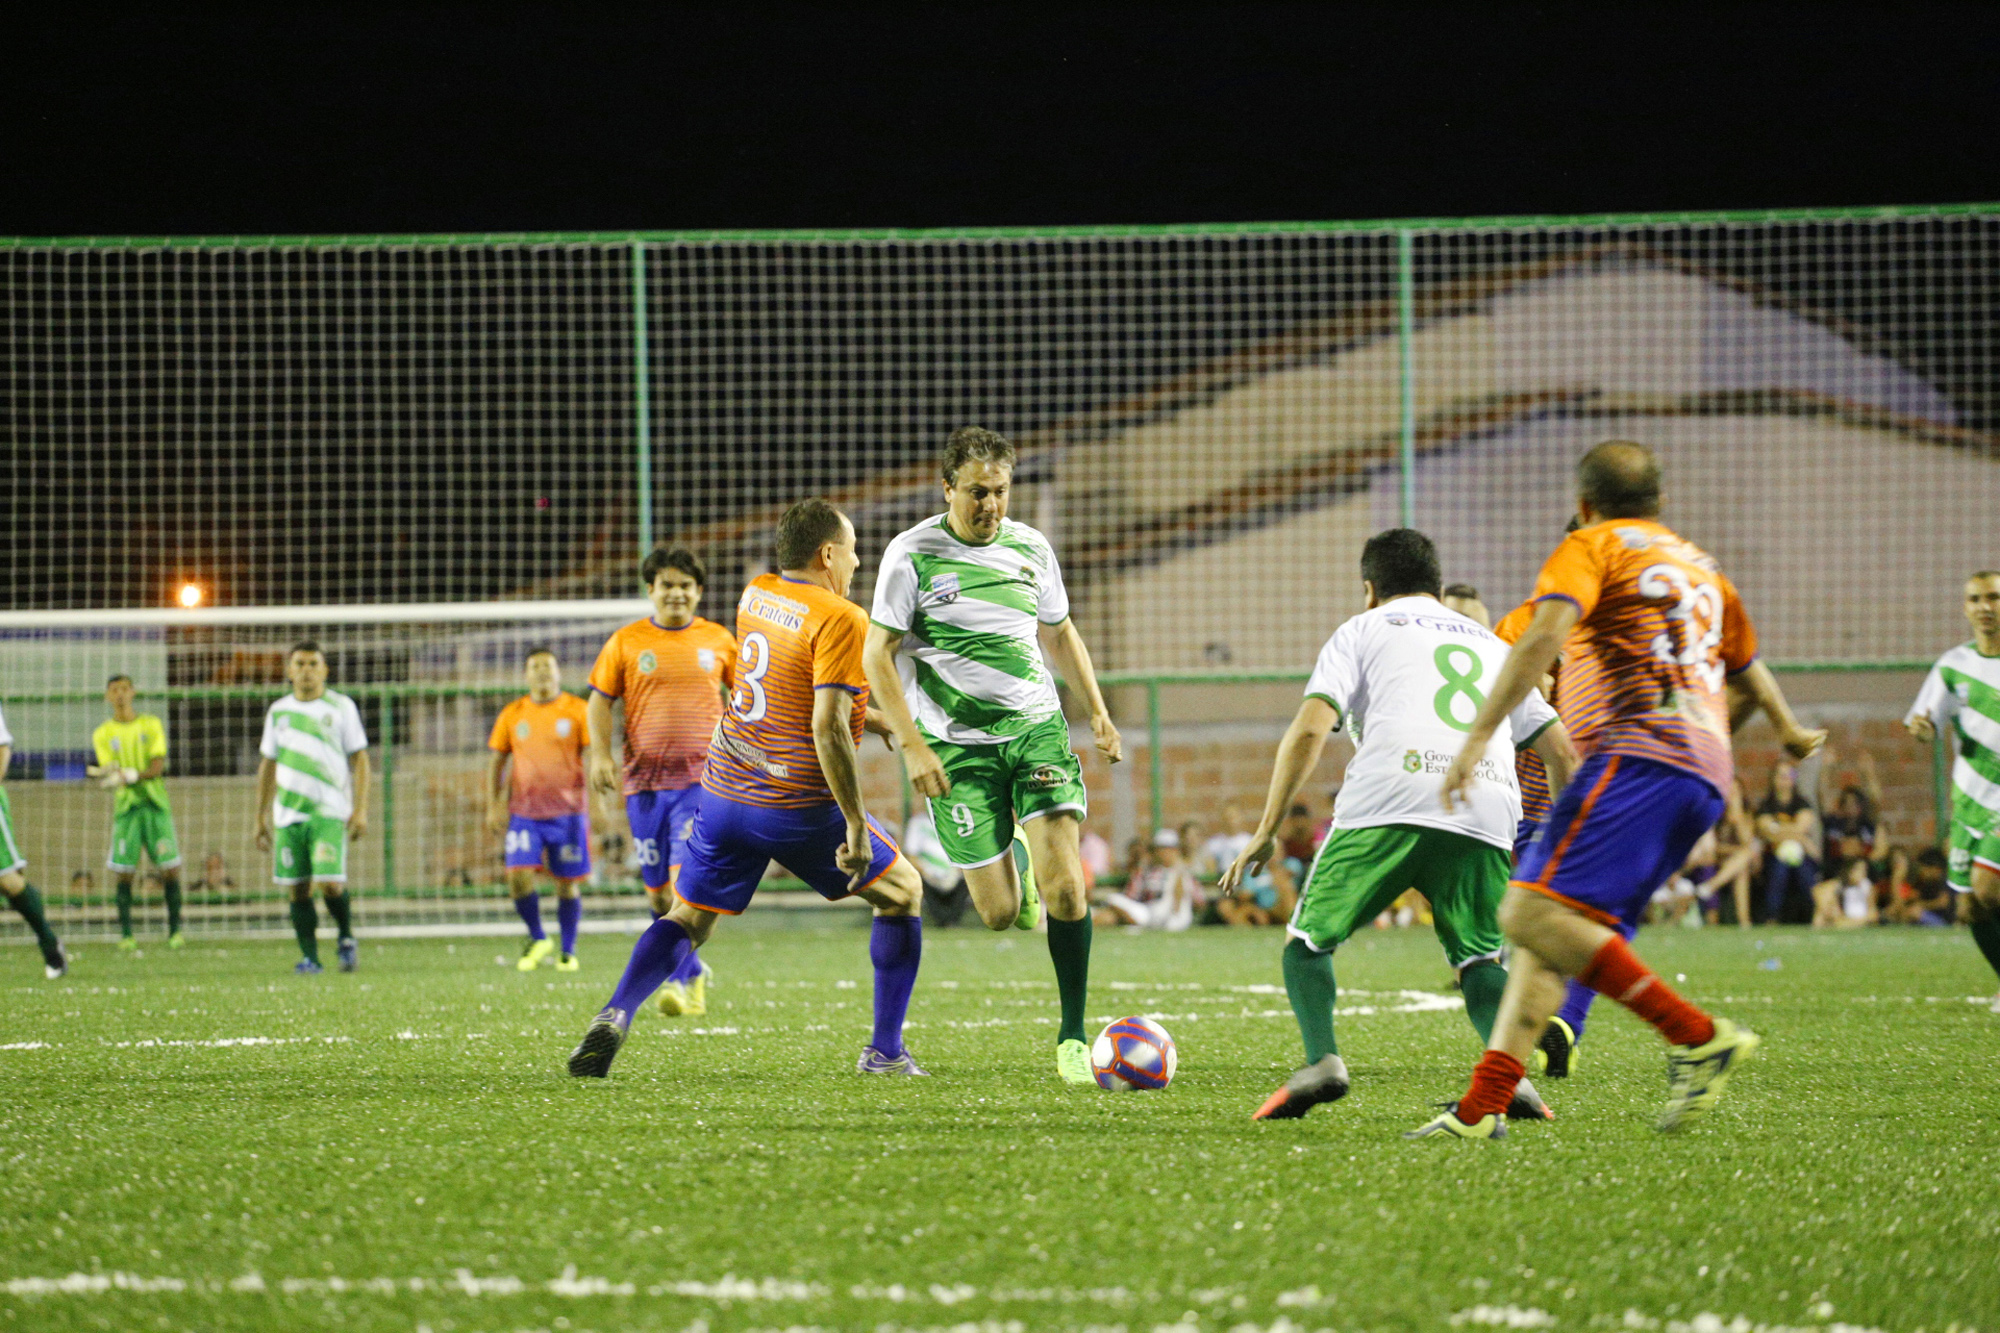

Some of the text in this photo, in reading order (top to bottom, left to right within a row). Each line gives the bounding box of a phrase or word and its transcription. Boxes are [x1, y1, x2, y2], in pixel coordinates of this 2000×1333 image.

[734, 631, 770, 722] 3
[1433, 643, 1488, 733] 8
[950, 803, 975, 838] 9
